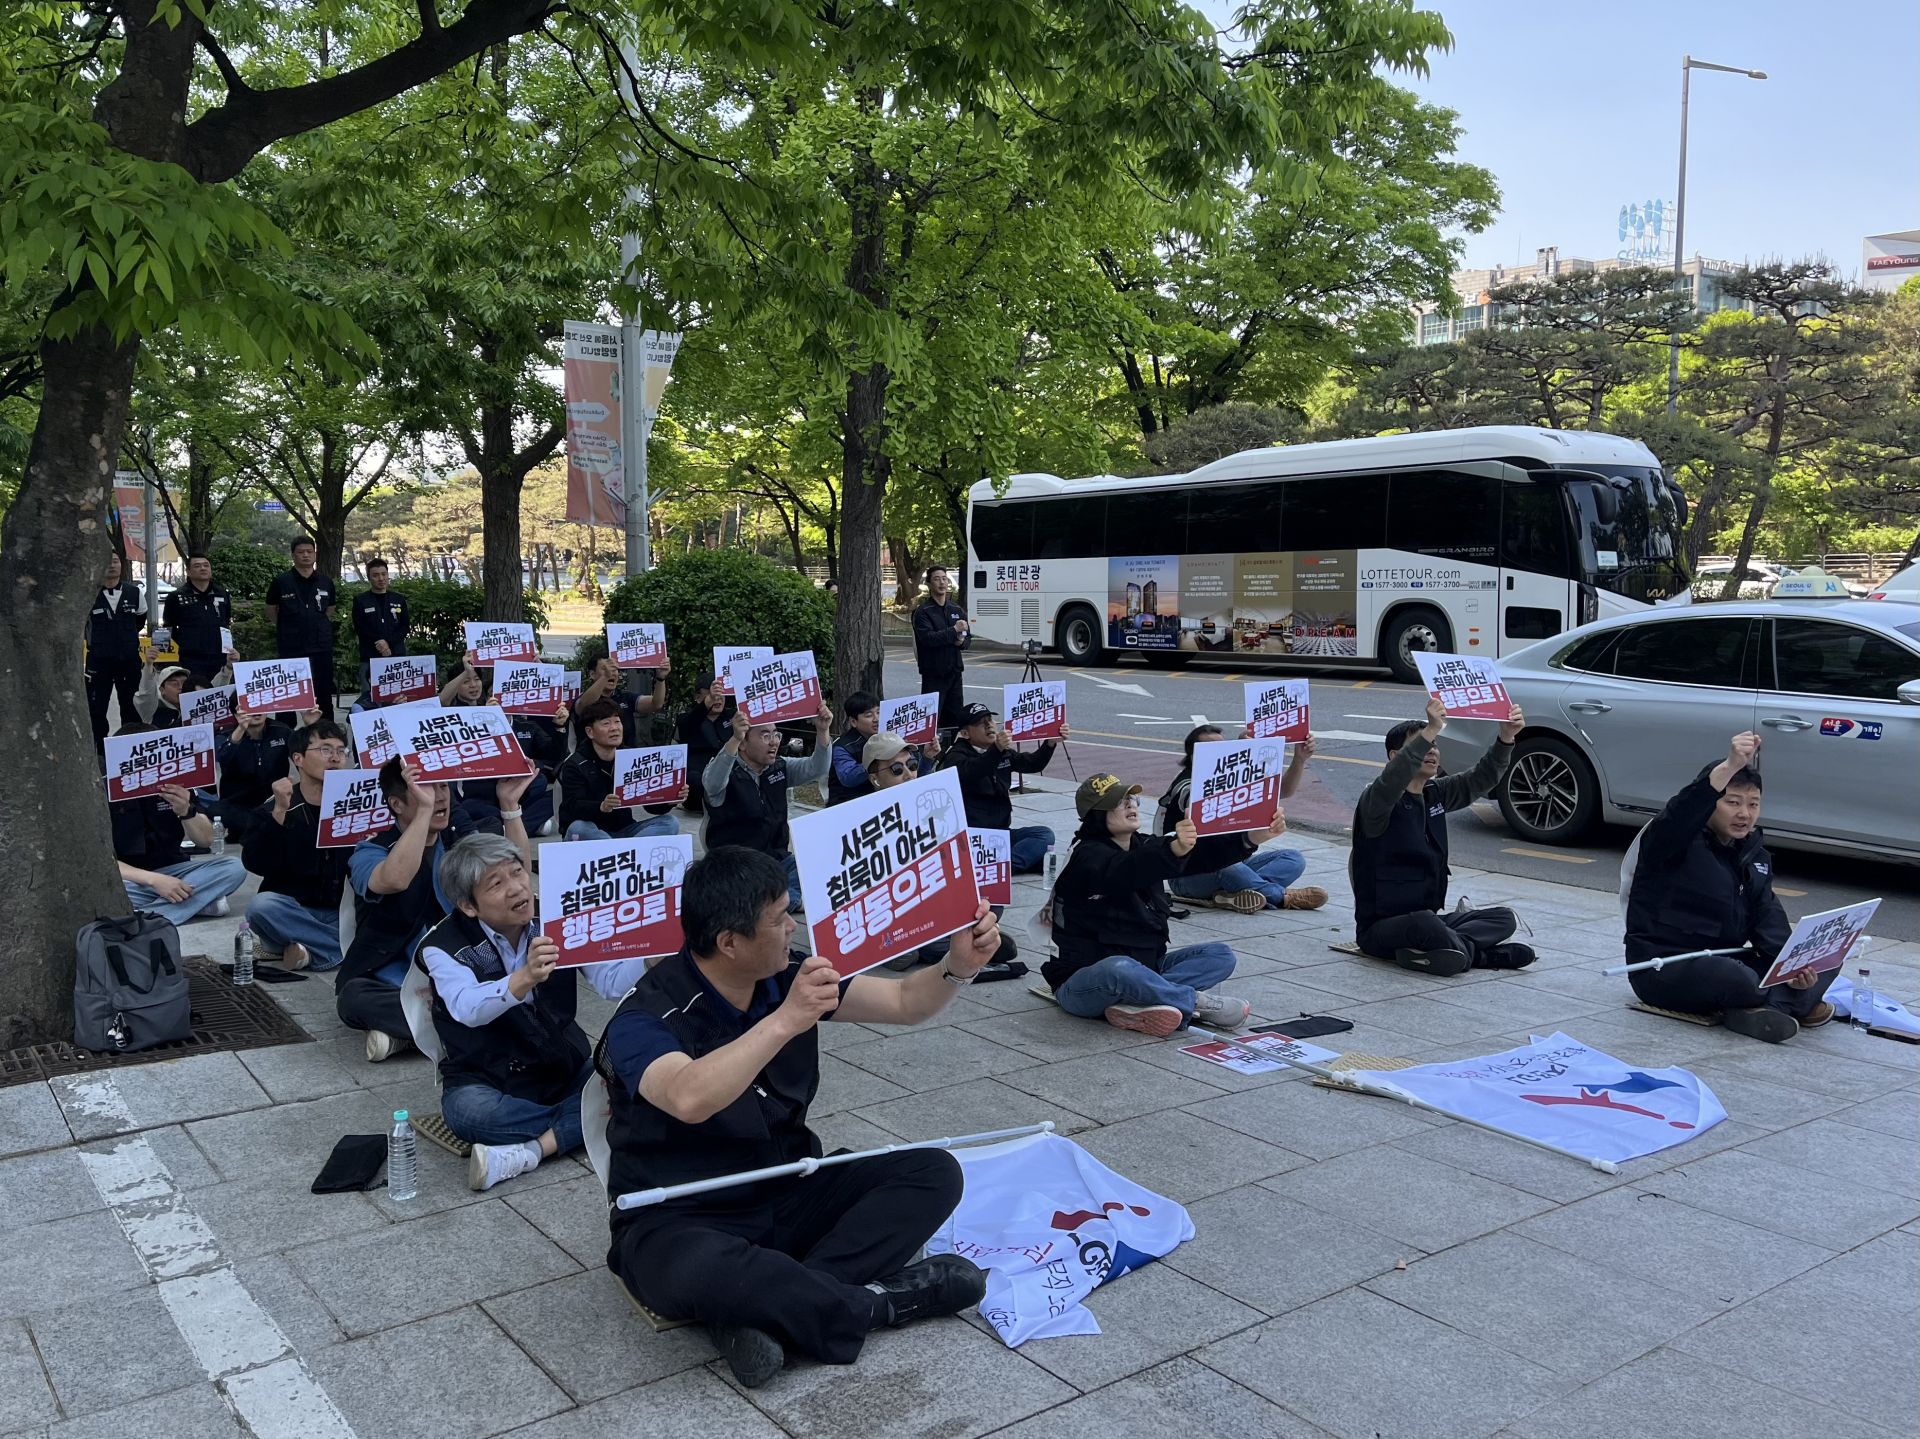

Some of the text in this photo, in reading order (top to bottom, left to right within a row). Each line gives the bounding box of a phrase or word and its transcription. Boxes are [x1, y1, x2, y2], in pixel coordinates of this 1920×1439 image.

[1872, 257, 1919, 266] TAEYOUNG
[996, 564, 1040, 580] 롯데관광
[1360, 568, 1461, 580] LOTTETOUR.com
[996, 582, 1040, 591] LOTTE TOUR
[251, 664, 283, 680] 사무직,
[509, 668, 539, 680] 사무직,
[752, 661, 786, 682] 사무직,
[1437, 660, 1470, 676] 사무직,
[244, 671, 296, 693] 침묵이 아닌
[501, 677, 549, 692] 침묵이 아닌
[744, 677, 776, 699] 침묵이
[779, 669, 801, 686] 아닌
[1433, 672, 1487, 691] 침묵이 아닌
[1016, 688, 1042, 705] 사무직,
[1259, 687, 1286, 705] 사무직,
[1010, 697, 1052, 719] 침묵이 아닌
[1253, 696, 1297, 720] 침묵이 아닌
[418, 714, 466, 734] 사무직,
[1824, 720, 1842, 732] 서울
[1864, 726, 1882, 737] 개인
[130, 735, 175, 757] 사무직,
[410, 724, 491, 752] 침묵이 아닌
[119, 742, 192, 774] 침묵이 아닌
[630, 752, 661, 769] 사무직,
[1212, 748, 1250, 775] 사무직,
[623, 760, 672, 784] 침묵이 아닌
[1202, 762, 1263, 798] 침묵이 아닌
[334, 794, 378, 816] 침묵이
[841, 801, 908, 865] 사무직,
[576, 850, 640, 886] 사무직,
[826, 816, 937, 910] 침묵이 아닌
[561, 867, 663, 917] 침묵이 아닌
